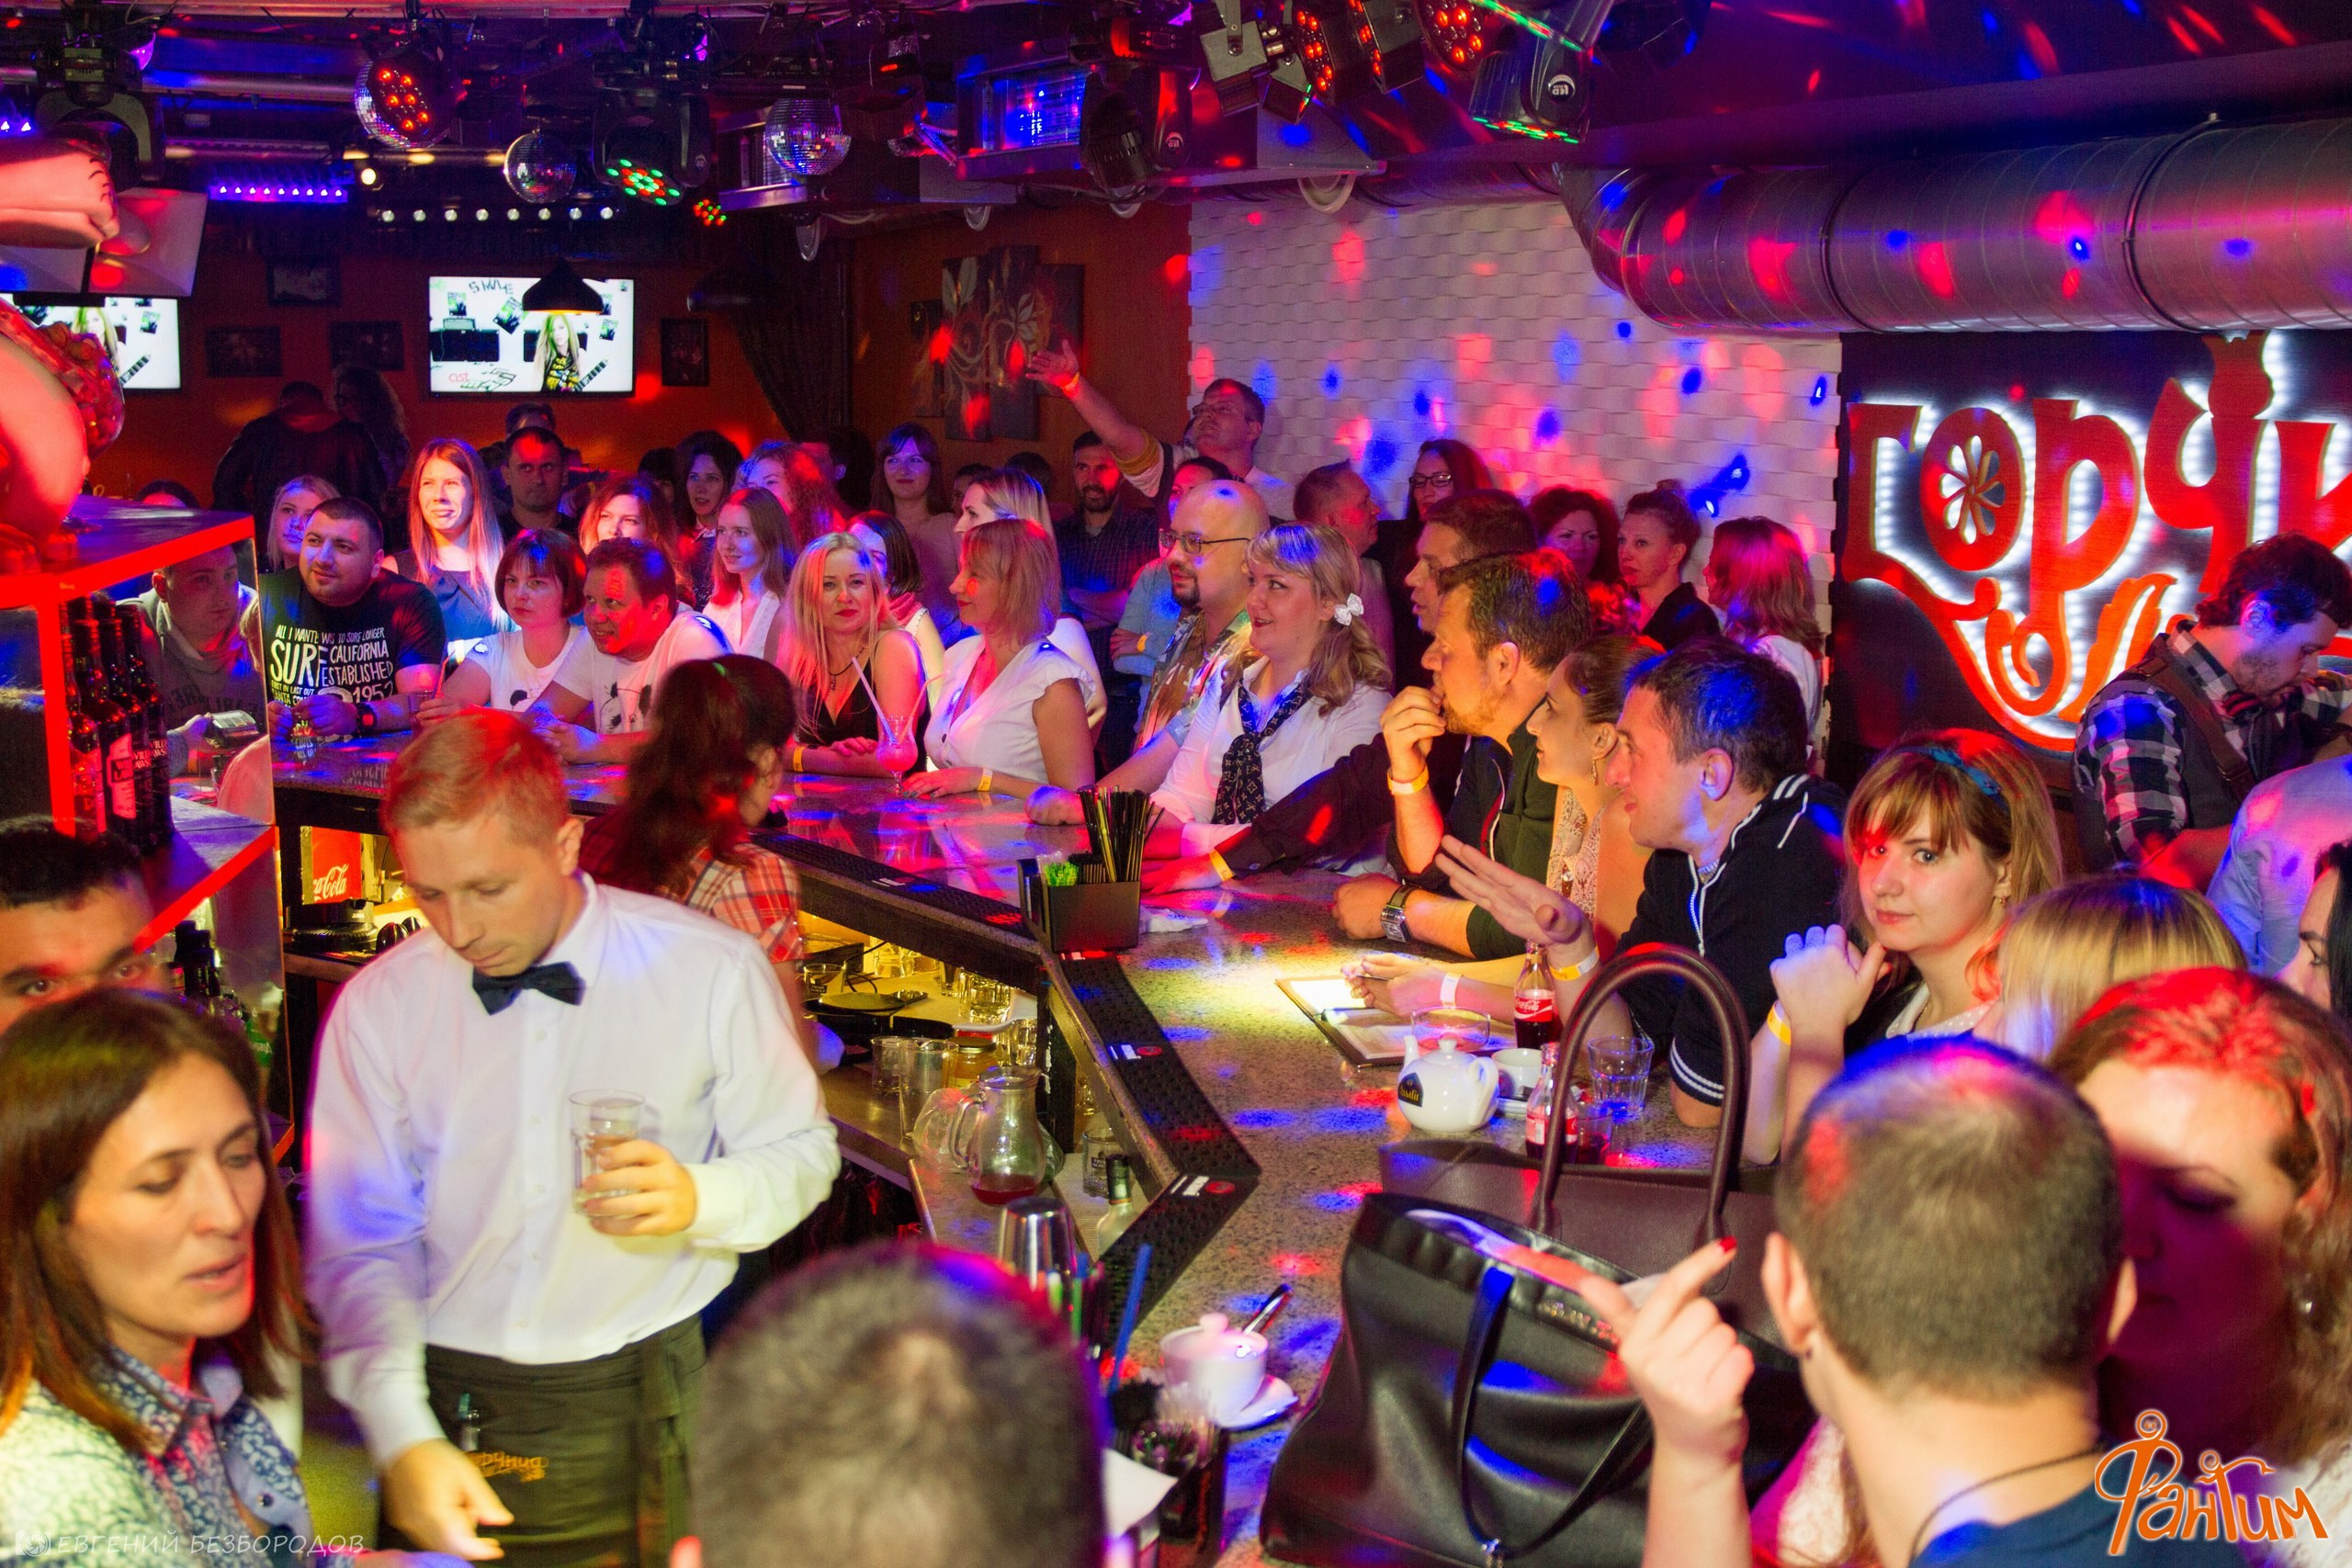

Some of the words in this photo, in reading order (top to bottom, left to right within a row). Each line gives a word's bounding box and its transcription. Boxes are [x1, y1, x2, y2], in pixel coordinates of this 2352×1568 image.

[276, 625, 287, 639] ALL
[288, 626, 293, 640] I
[346, 632, 362, 643] SURF
[362, 627, 385, 641] LONGER
[270, 638, 329, 688] SURF
[330, 639, 390, 664] CALIFORNIA
[322, 660, 394, 687] ESTABLISHED
[290, 685, 303, 695] LAST
[303, 687, 315, 696] OUT
[352, 680, 394, 705] 1952
